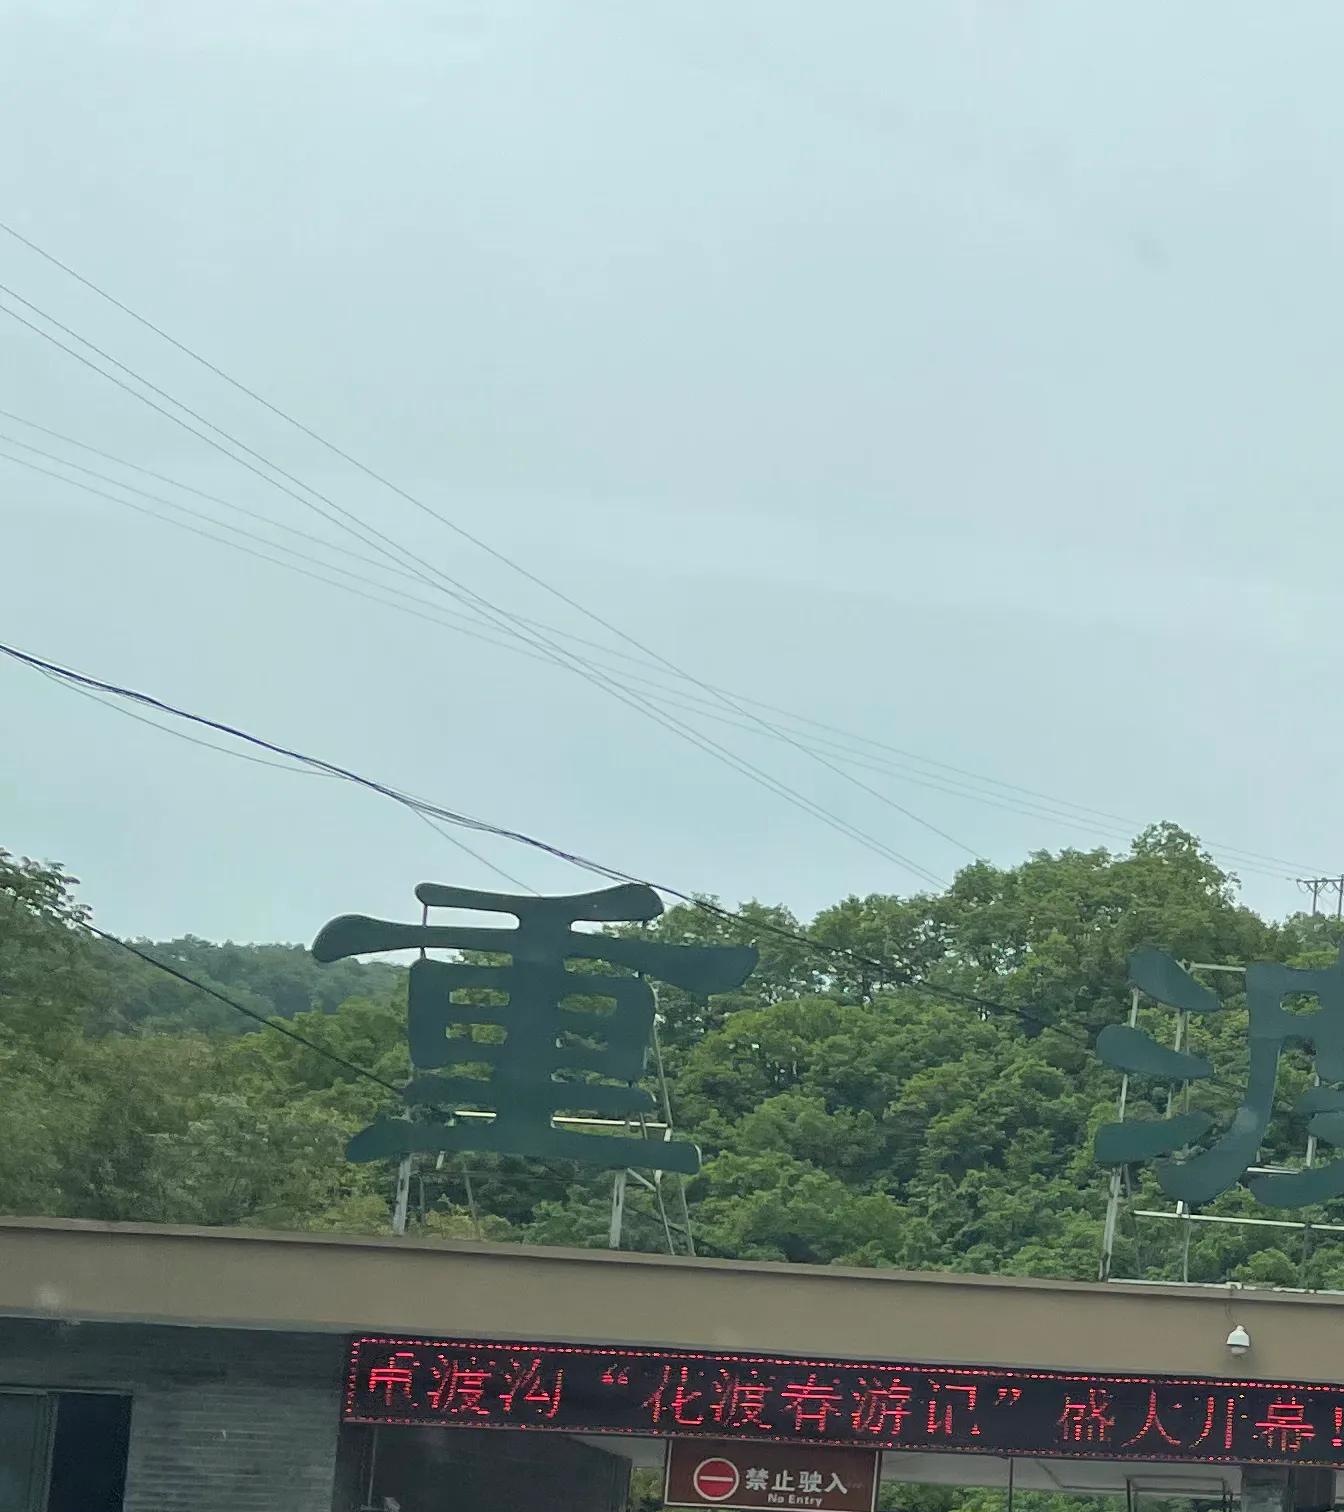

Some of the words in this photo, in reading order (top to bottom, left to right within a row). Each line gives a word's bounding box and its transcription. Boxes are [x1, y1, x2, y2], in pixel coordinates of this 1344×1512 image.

[745, 1467, 848, 1495] 禁止驶入
[767, 1493, 785, 1504] No
[788, 1494, 823, 1507] Entry
